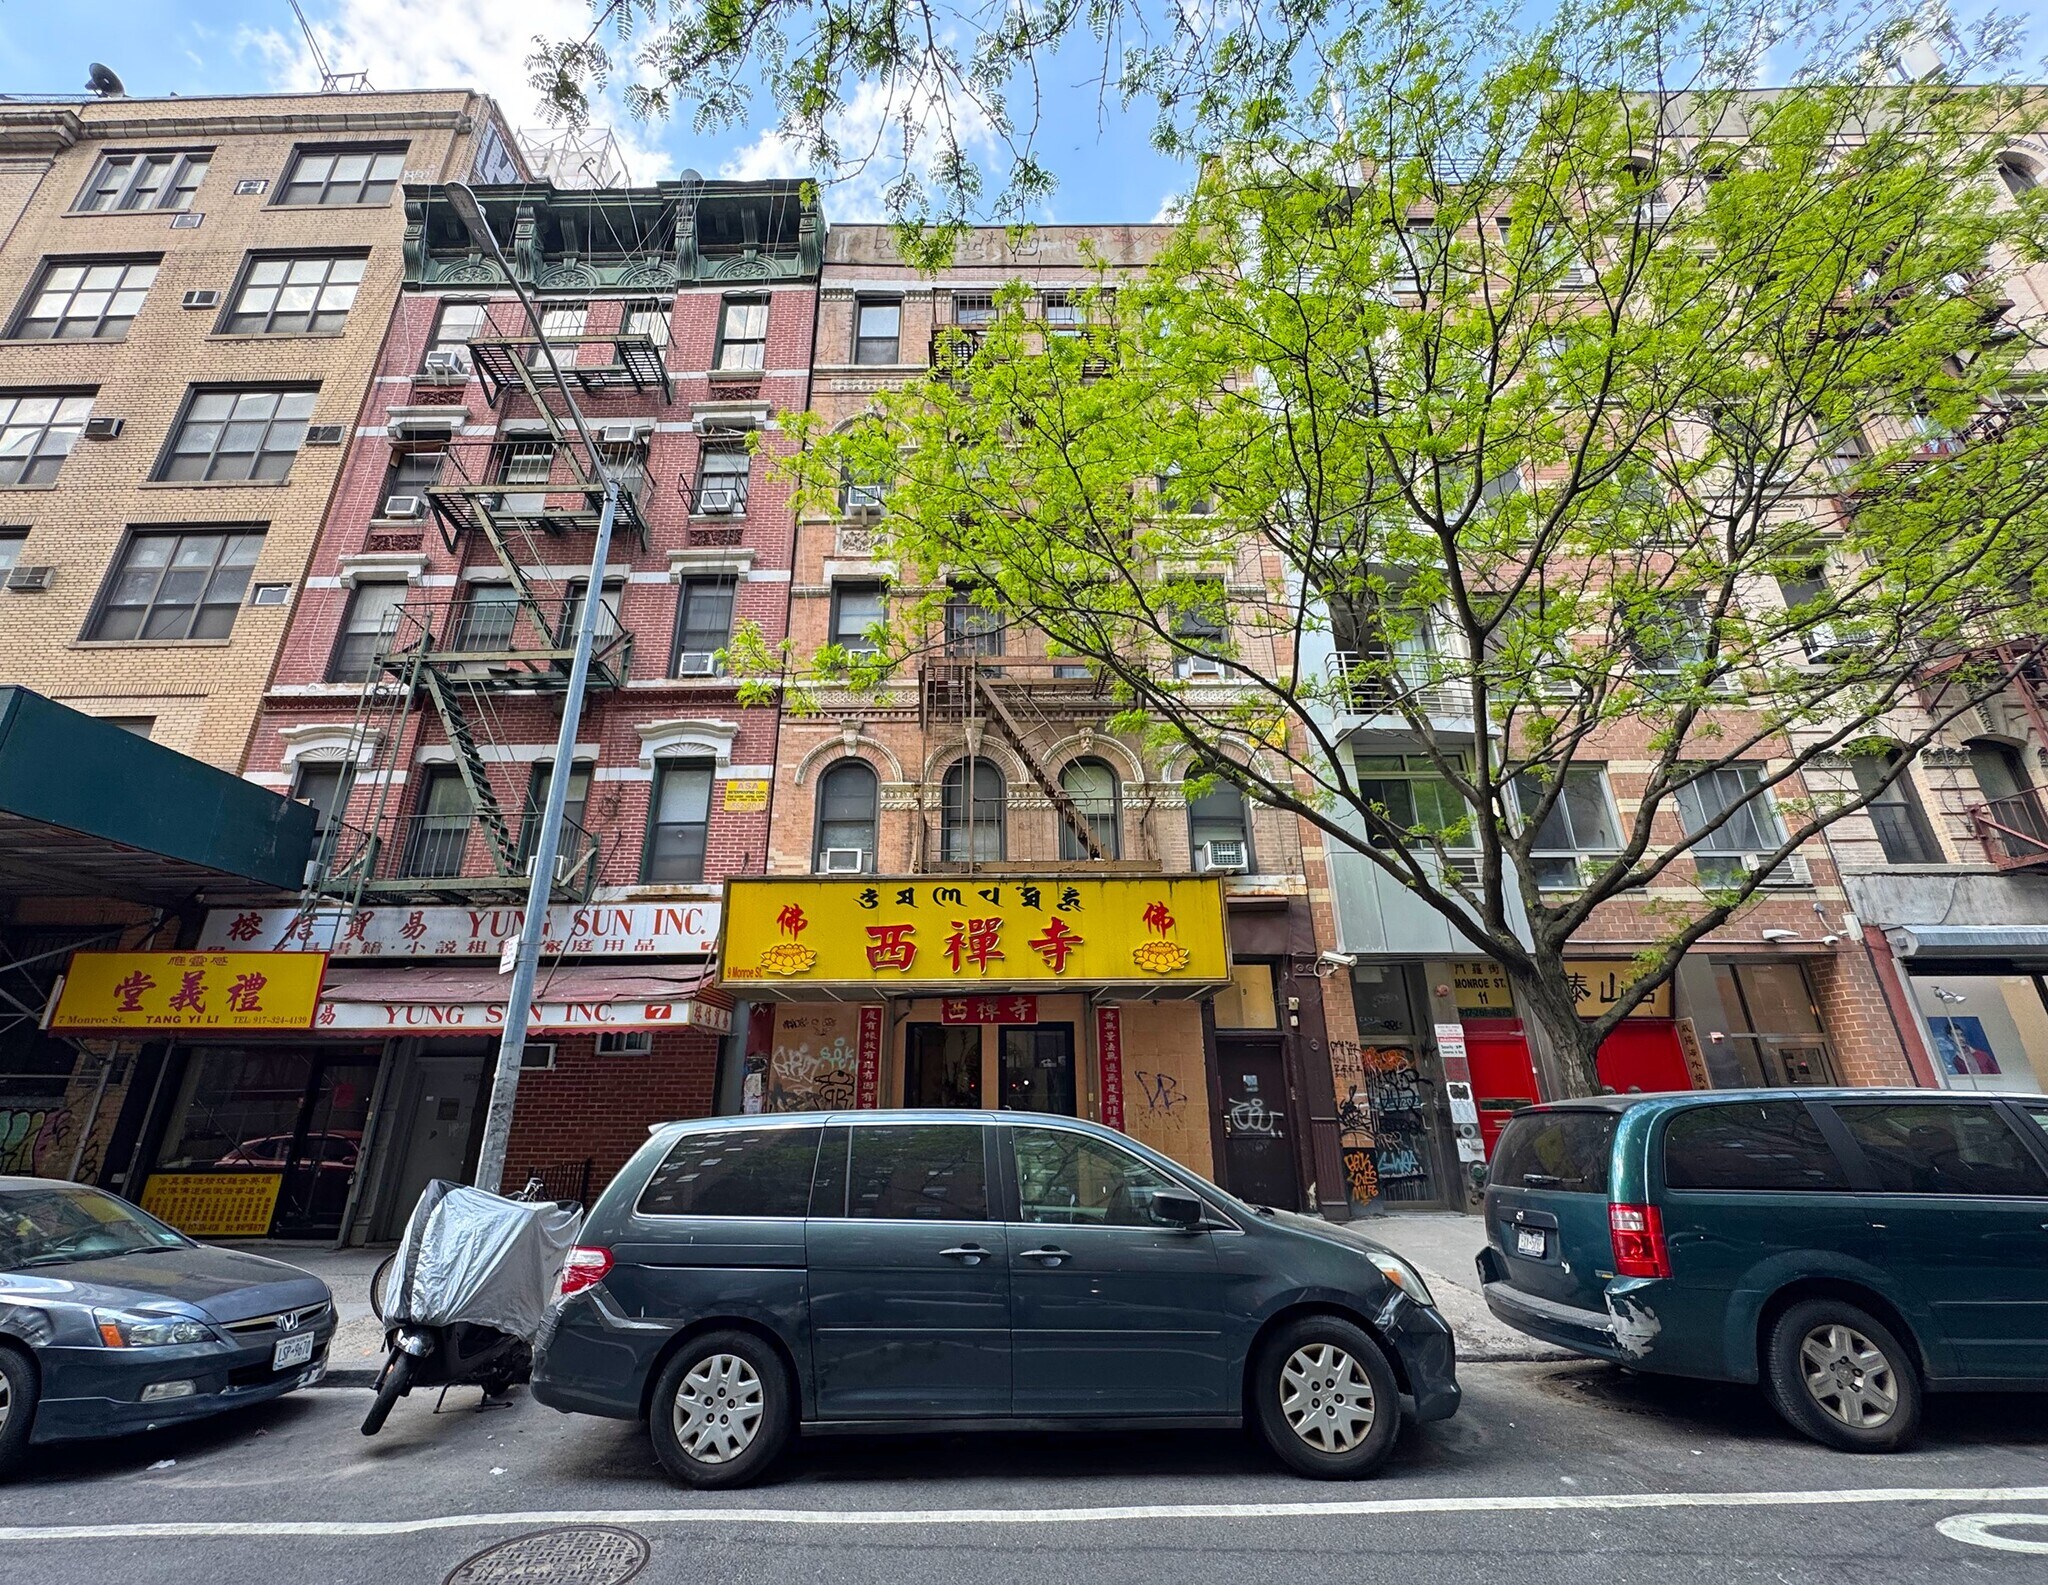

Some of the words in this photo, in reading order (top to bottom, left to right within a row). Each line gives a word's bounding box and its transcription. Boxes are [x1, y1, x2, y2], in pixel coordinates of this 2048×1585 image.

[572, 908, 634, 937] SUN
[653, 908, 706, 937] INC.
[777, 903, 809, 940] 佛
[1143, 901, 1176, 939] 佛
[865, 917, 1085, 975] 西禪寺
[727, 967, 732, 978] 9
[733, 967, 754, 978] Monroe
[755, 967, 764, 978] St.
[1454, 979, 1490, 989] MONROE
[1494, 978, 1507, 989] ST.
[1478, 991, 1489, 1005] 11
[58, 1015, 65, 1024] 7
[67, 1015, 109, 1024] Monroe
[110, 1015, 126, 1024] St.
[145, 1015, 182, 1024] TANG
[188, 1015, 202, 1024] YI
[206, 1015, 220, 1024] LI
[384, 1005, 465, 1025] YUNG
[486, 1003, 545, 1024] SN
[564, 1003, 616, 1023] INC.
[948, 997, 1033, 1022] 西禪寺
